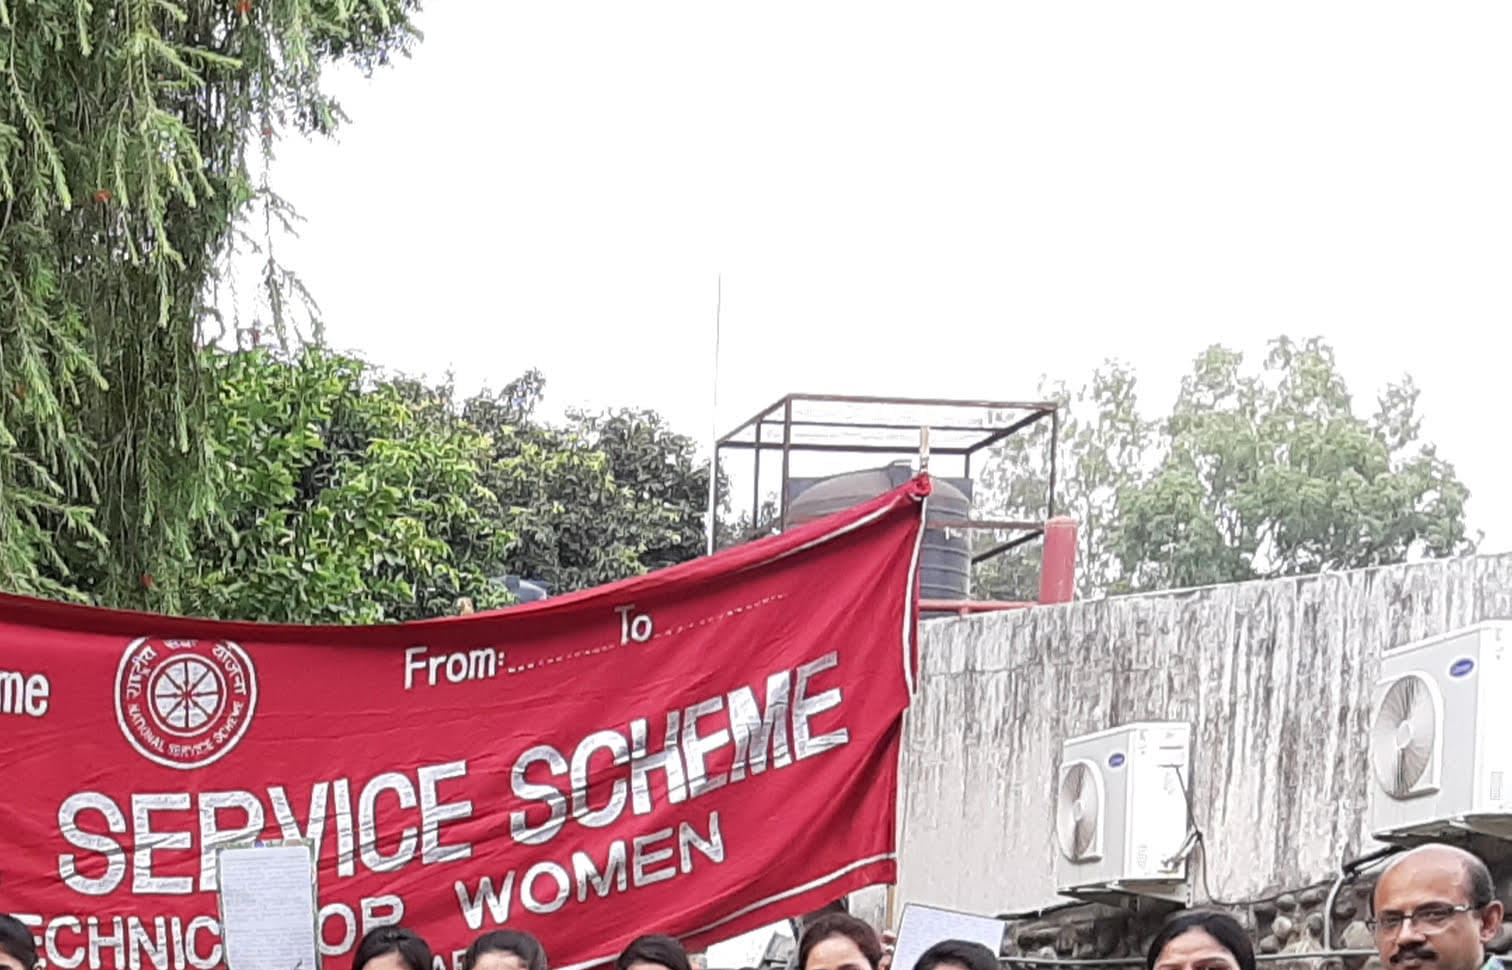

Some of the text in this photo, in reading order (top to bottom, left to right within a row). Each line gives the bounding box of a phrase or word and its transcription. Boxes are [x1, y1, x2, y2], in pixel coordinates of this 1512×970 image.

[128, 703, 165, 753] NATIONAL
[212, 700, 245, 744] SCHEME
[509, 652, 850, 846] SCHEME
[454, 811, 725, 931] WOMEN
